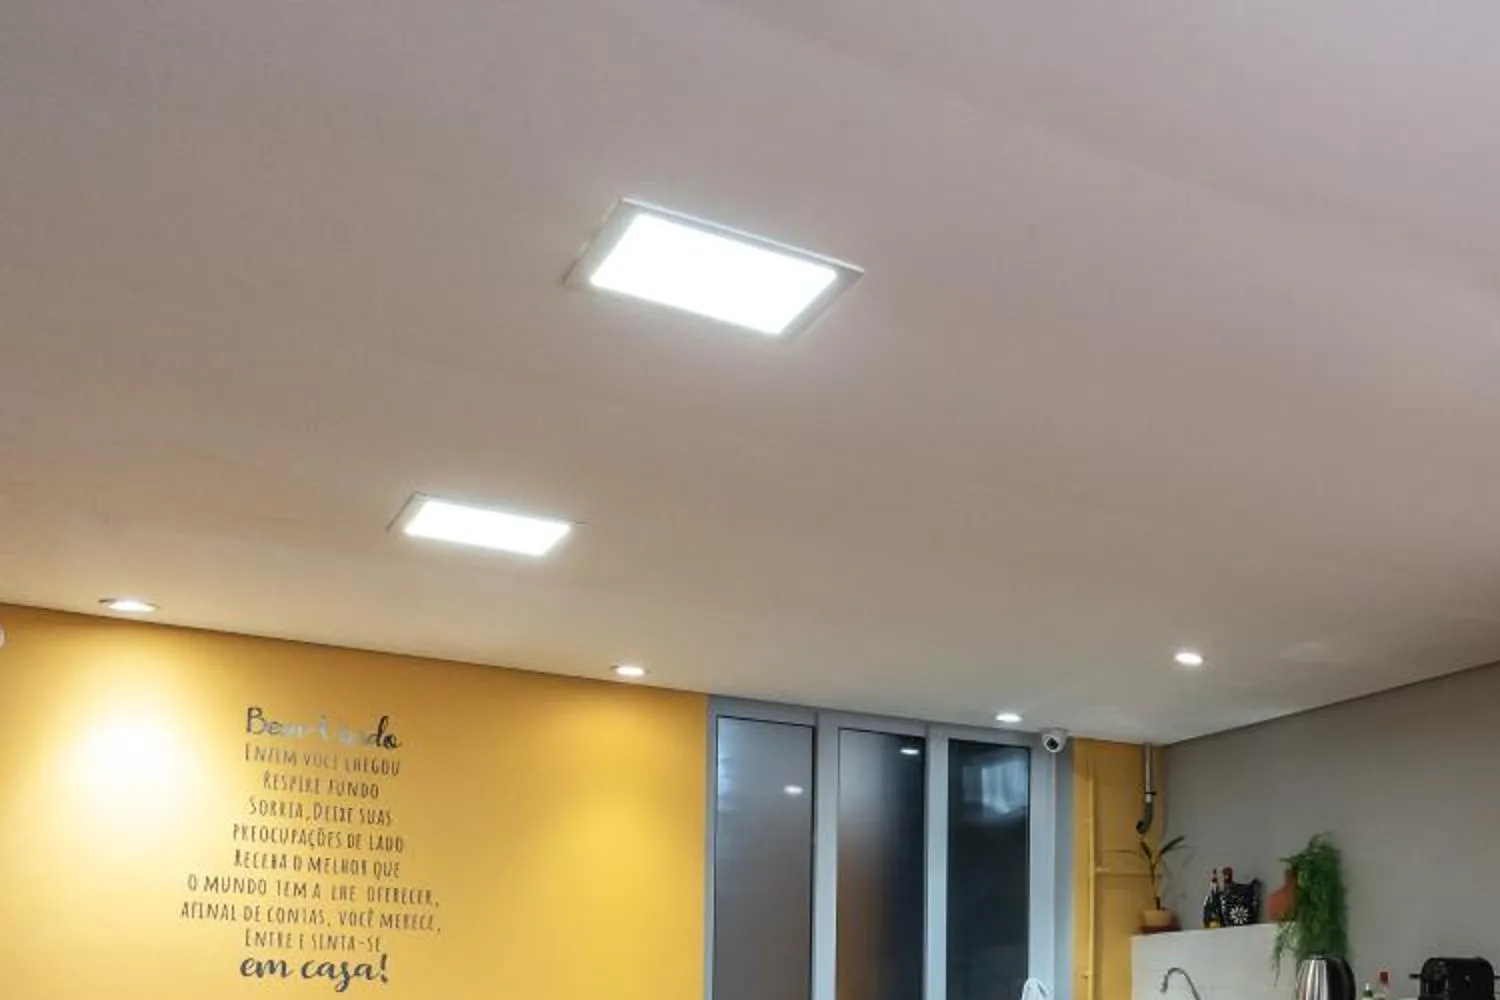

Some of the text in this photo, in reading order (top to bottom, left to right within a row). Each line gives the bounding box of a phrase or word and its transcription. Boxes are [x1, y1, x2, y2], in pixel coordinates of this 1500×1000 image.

[345, 757, 400, 776] CHEGOU
[263, 771, 379, 800] RESPIRE FUNDO
[359, 808, 391, 826] SUAS
[233, 823, 403, 854] PREOCUPAÇÕES DE LADO
[234, 849, 400, 880] RECEBA O MELHOR QUE
[188, 874, 197, 891] O
[203, 876, 267, 896] MUNDO
[276, 881, 307, 897] TEM
[309, 883, 321, 899] A
[331, 885, 356, 901] LHE
[181, 901, 236, 921] AFINAL
[243, 904, 260, 922] DE
[338, 907, 373, 927] VOCÊ
[245, 927, 292, 949] ENTRE
[240, 953, 389, 992] em casa!
